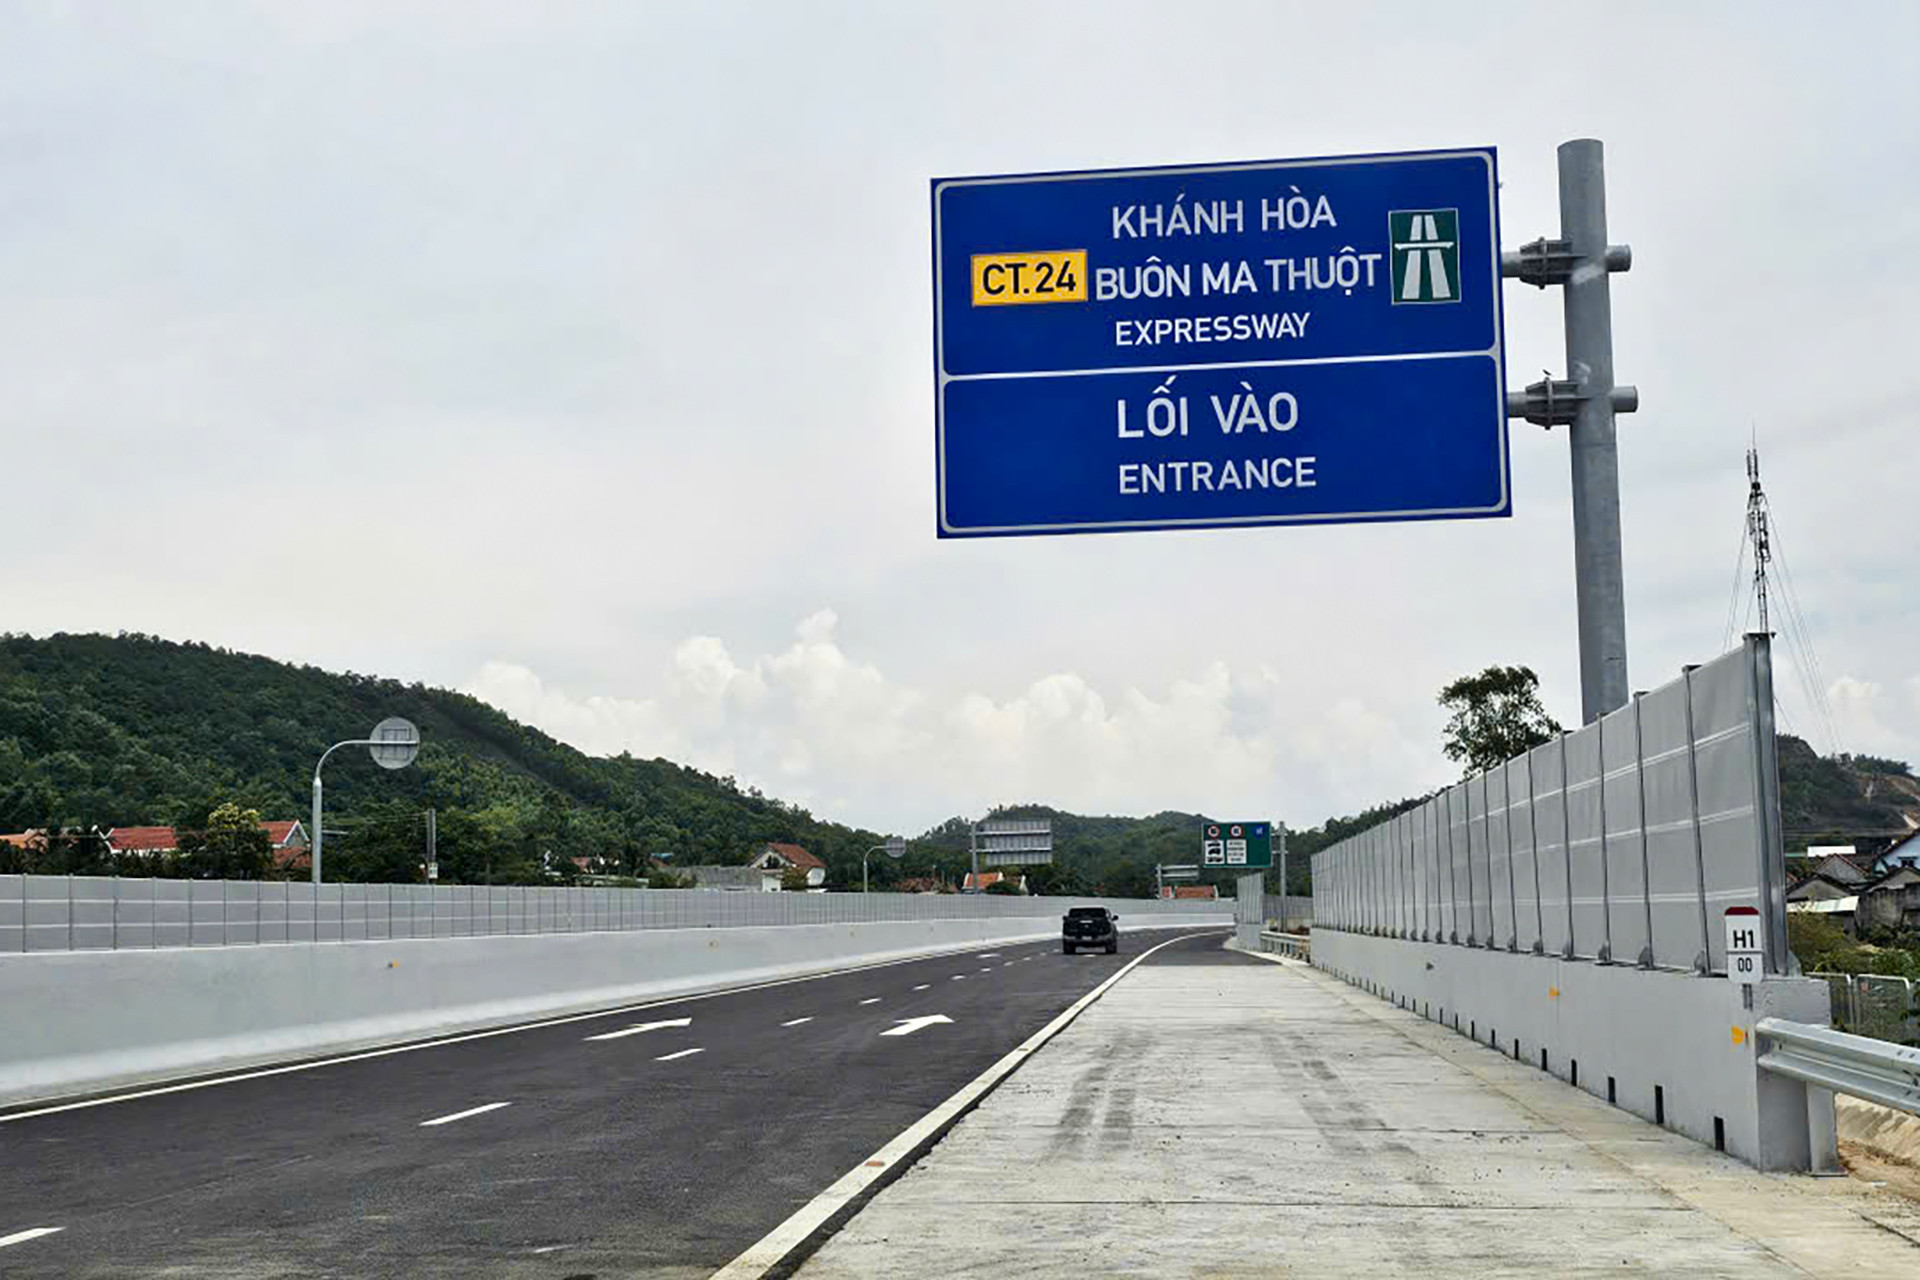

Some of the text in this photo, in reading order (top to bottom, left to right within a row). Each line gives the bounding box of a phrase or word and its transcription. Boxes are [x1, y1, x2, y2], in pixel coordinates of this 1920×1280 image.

[1112, 185, 1337, 239] KHÁNH HÒA
[982, 260, 1078, 296] CT.24
[1095, 245, 1382, 301] BUÔN MA THUỘT
[1115, 312, 1311, 346] EXPRESSWAY
[1117, 374, 1298, 438] LỐI VÀO
[1119, 456, 1317, 494] ENTRANCE
[1732, 929, 1755, 949] H1
[1736, 956, 1754, 974] 00
